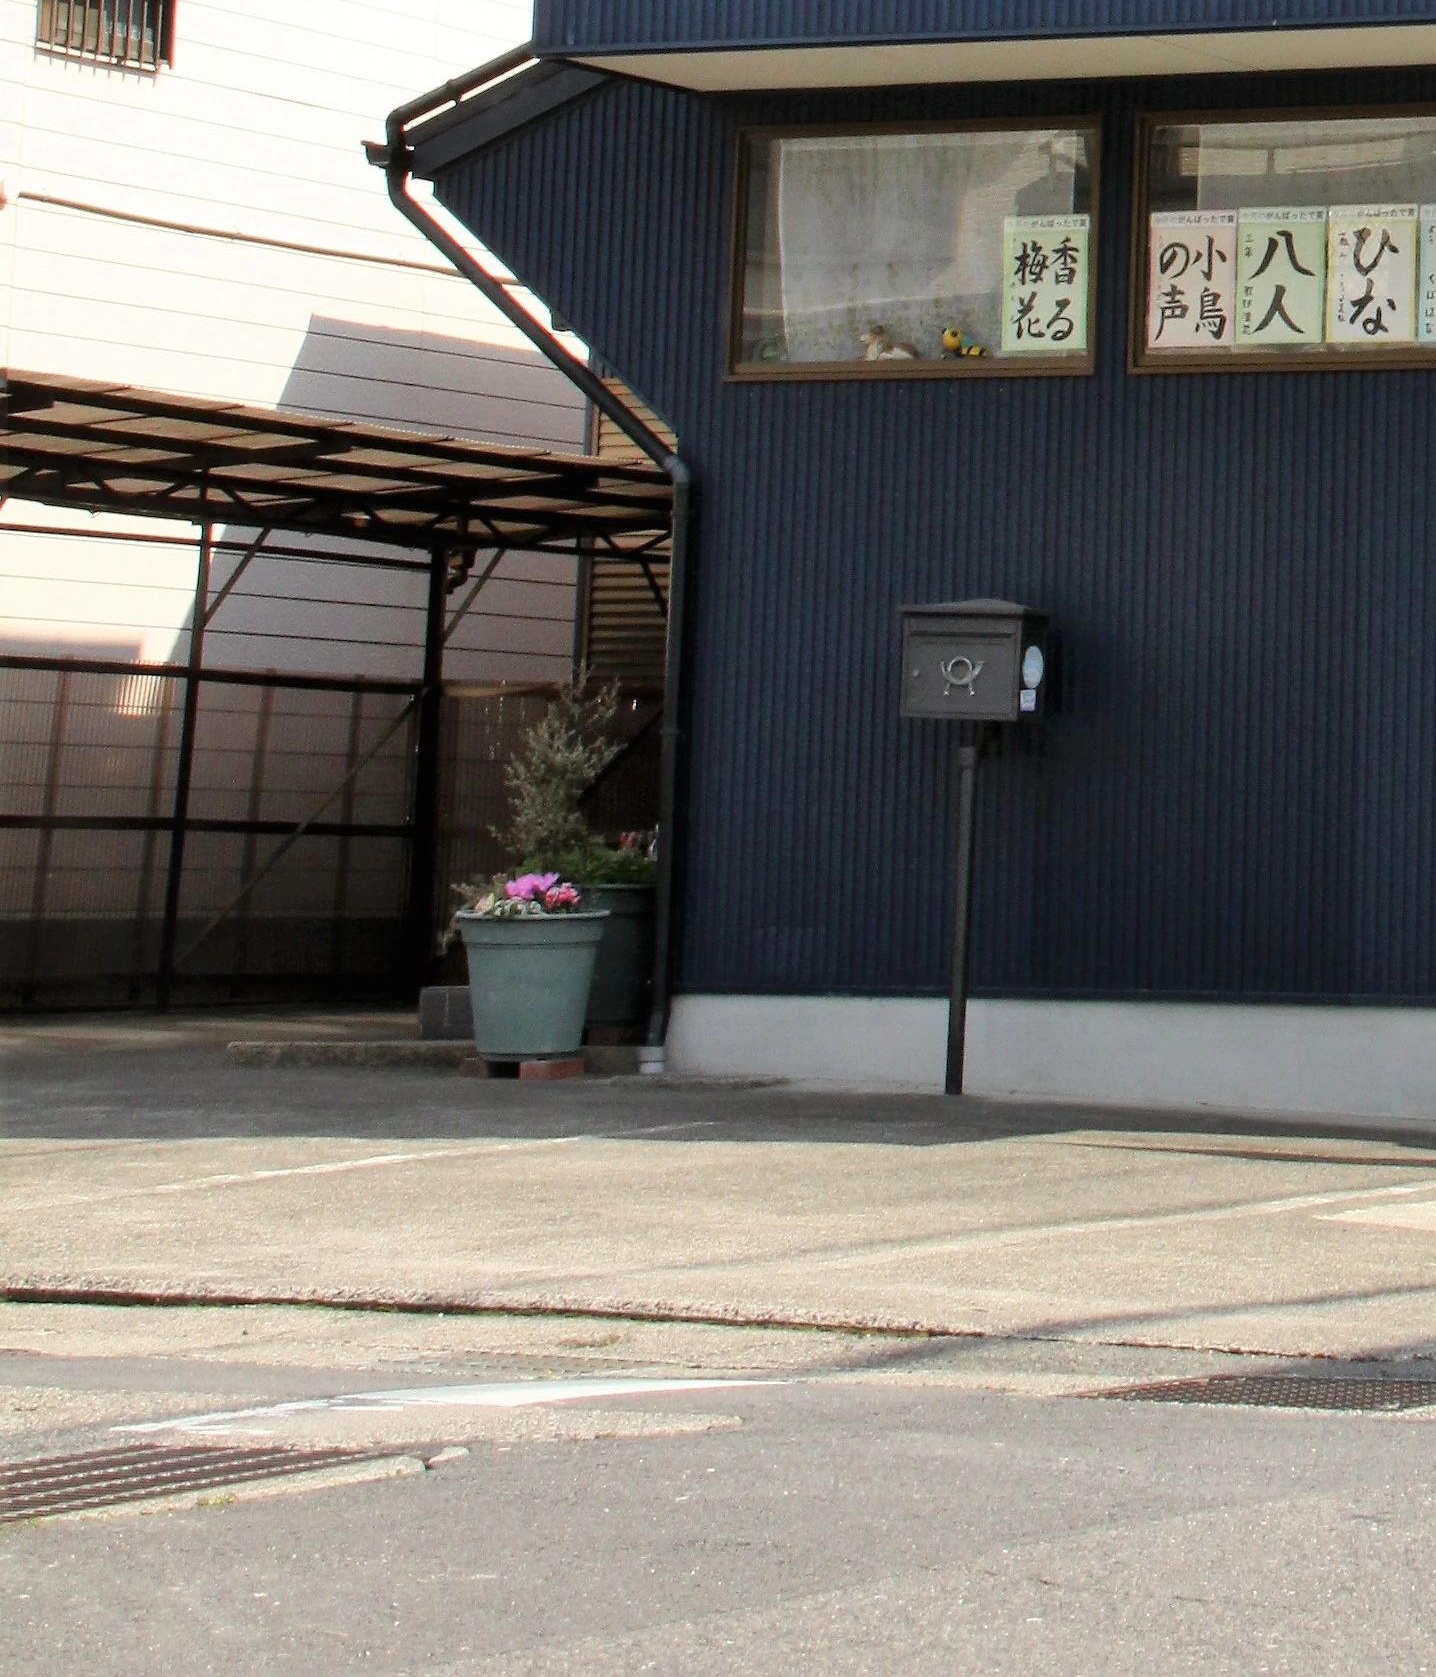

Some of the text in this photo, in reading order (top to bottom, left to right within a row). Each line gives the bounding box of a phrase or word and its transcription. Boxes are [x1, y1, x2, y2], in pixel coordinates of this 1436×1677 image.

[1047, 236, 1079, 341] 香る
[1155, 242, 1189, 341] の声
[1191, 235, 1227, 340] 小鳥
[1249, 230, 1317, 334] 八人
[1350, 227, 1399, 336] ひな
